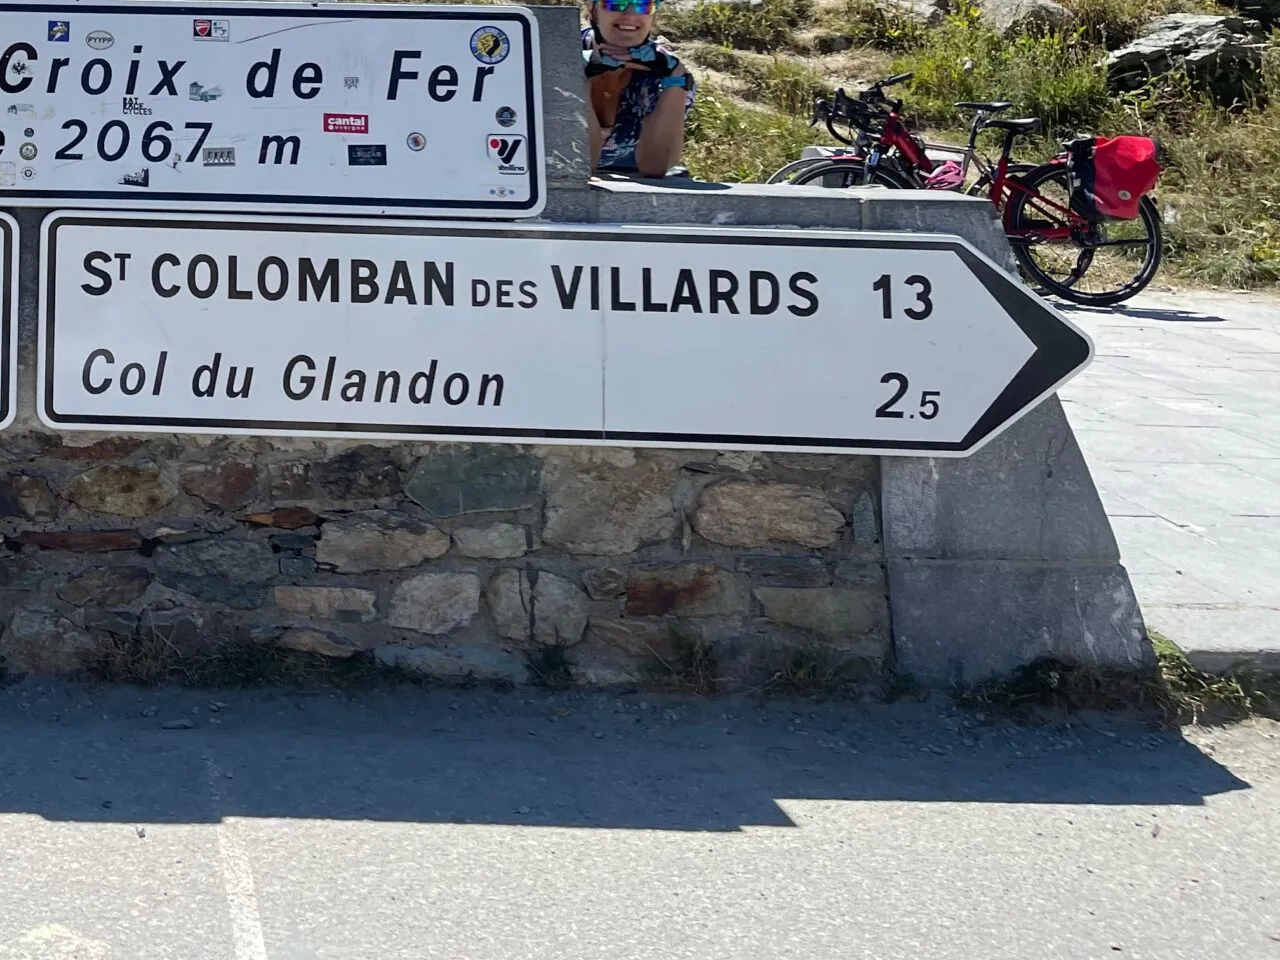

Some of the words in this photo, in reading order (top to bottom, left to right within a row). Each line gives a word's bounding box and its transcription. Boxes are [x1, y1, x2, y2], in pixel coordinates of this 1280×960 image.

[246, 48, 323, 100] de
[387, 50, 496, 103] Fer
[54, 119, 214, 164] 2067
[258, 135, 301, 165] m
[327, 116, 366, 126] cantal
[151, 252, 454, 307] COLOMBAN
[471, 279, 538, 309] DES
[550, 264, 819, 317] VILLARDS
[873, 274, 933, 321] 13
[82, 348, 168, 396] Col
[192, 352, 254, 399] du
[282, 354, 504, 407] Glandon
[875, 372, 941, 420] 2.5
